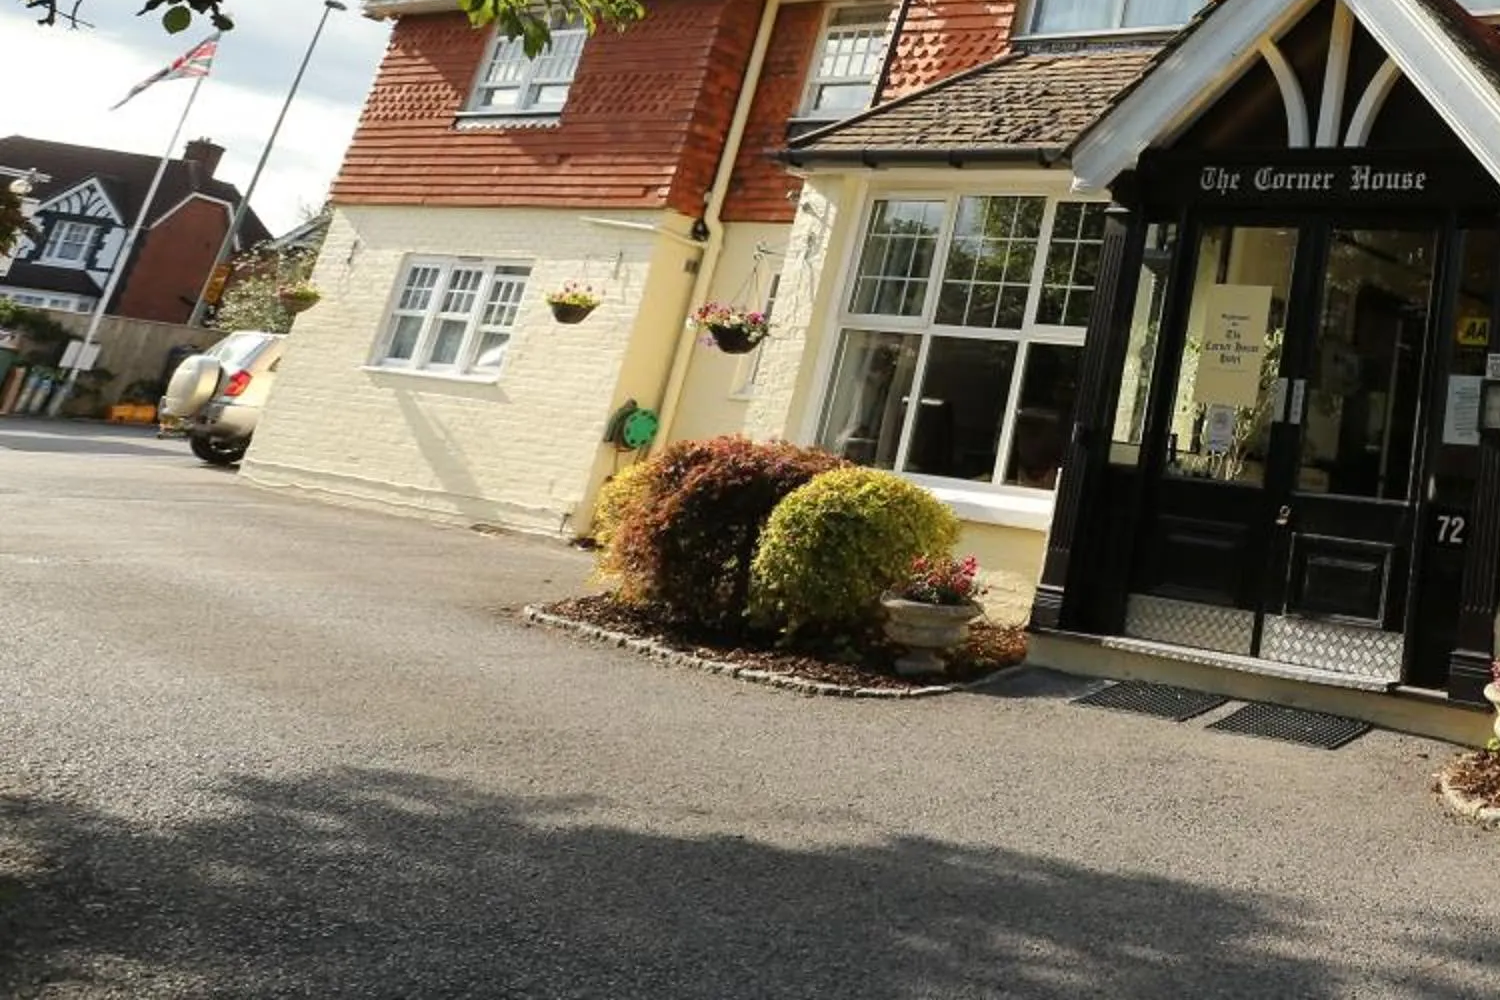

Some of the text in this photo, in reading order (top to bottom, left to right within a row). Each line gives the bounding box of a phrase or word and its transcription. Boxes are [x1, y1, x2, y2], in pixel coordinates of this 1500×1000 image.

[1200, 165, 1428, 196] The Corner House
[1437, 515, 1465, 543] 72
